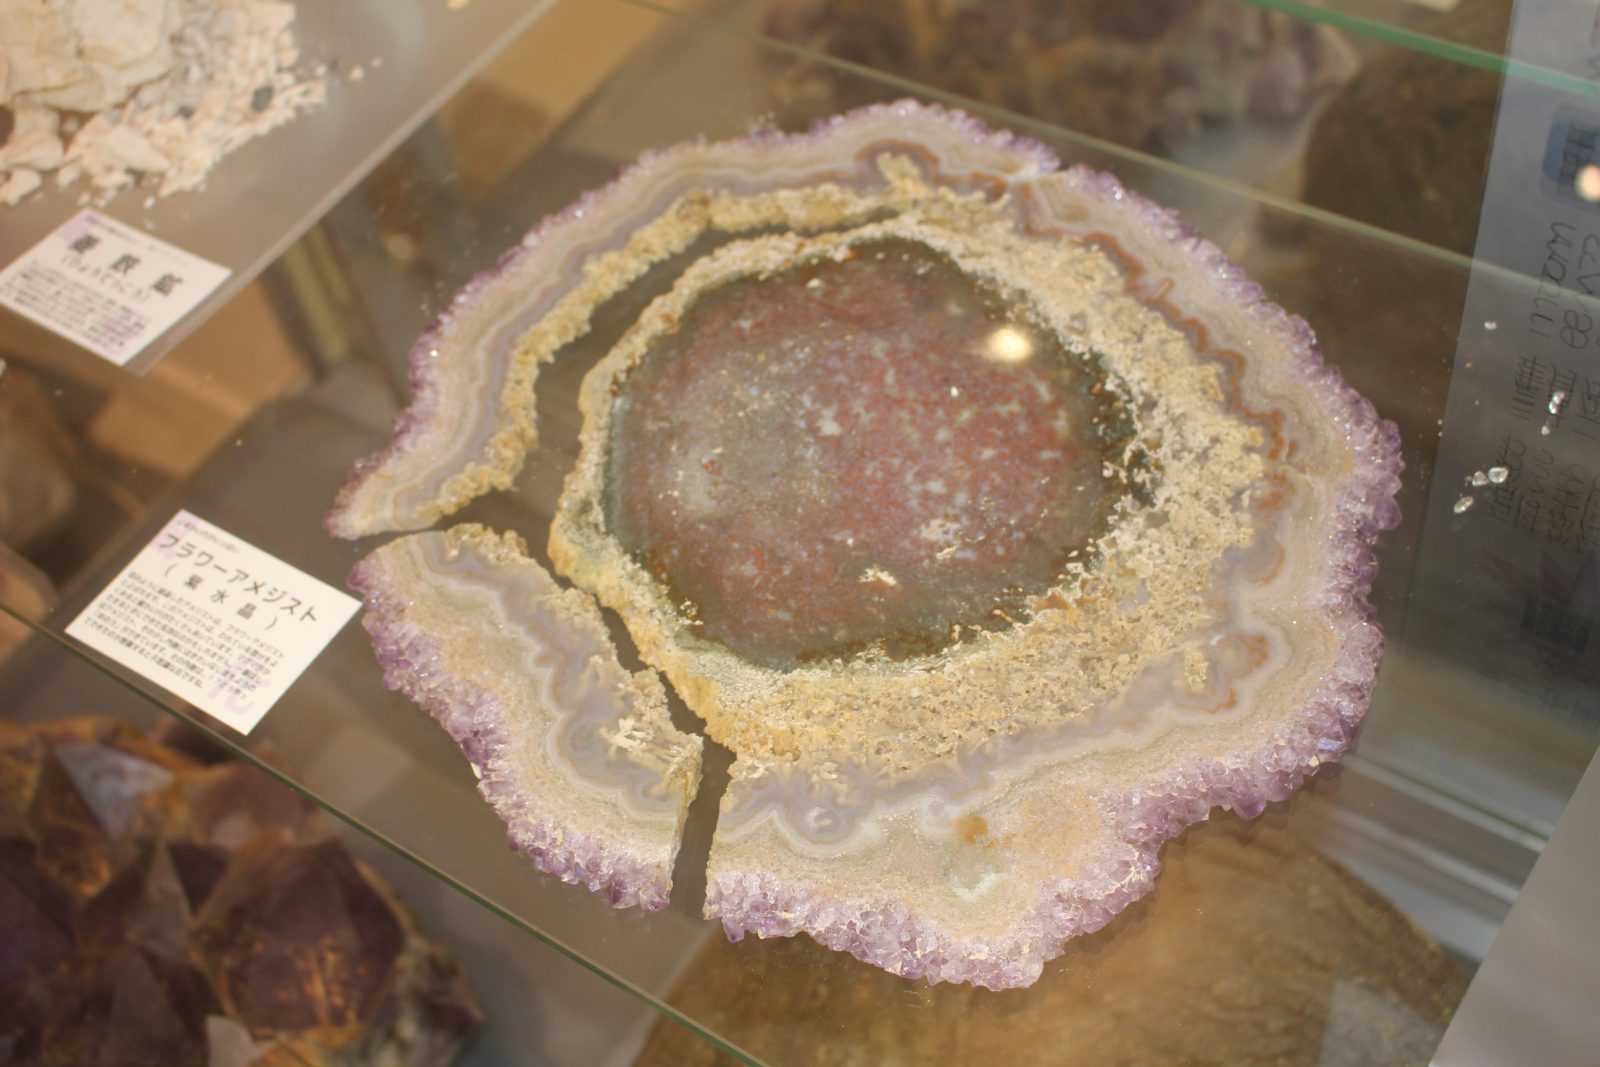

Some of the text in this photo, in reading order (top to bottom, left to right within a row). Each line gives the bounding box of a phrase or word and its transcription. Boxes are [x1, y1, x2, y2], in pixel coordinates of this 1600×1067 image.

[159, 533, 316, 621] フラワーアメジスト
